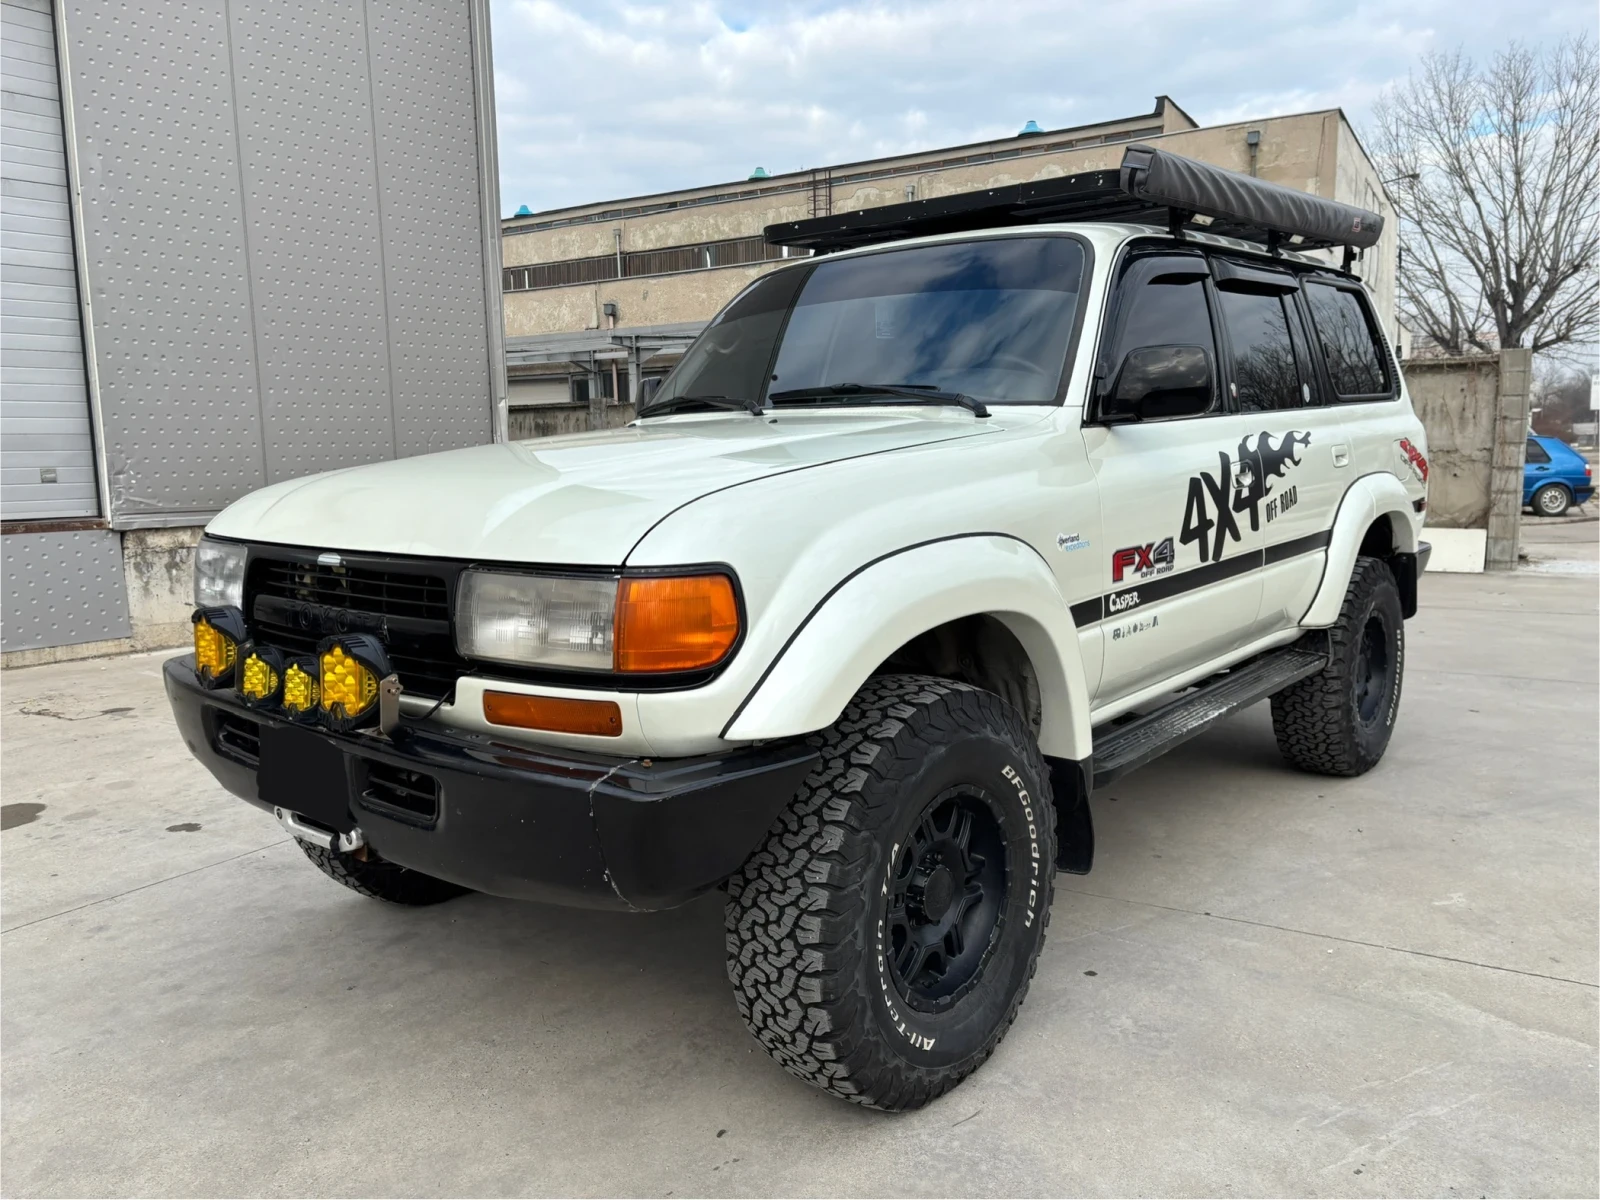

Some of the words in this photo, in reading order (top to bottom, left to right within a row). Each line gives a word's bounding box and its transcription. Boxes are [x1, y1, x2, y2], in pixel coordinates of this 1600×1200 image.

[1266, 498, 1277, 523] OFF
[1280, 485, 1298, 513] ROAD
[1112, 536, 1175, 584] FX4
[1141, 569, 1155, 578] OFF
[1157, 565, 1174, 575] ROAD
[880, 843, 899, 897] T/A
[1001, 764, 1040, 928] BFGoodrich
